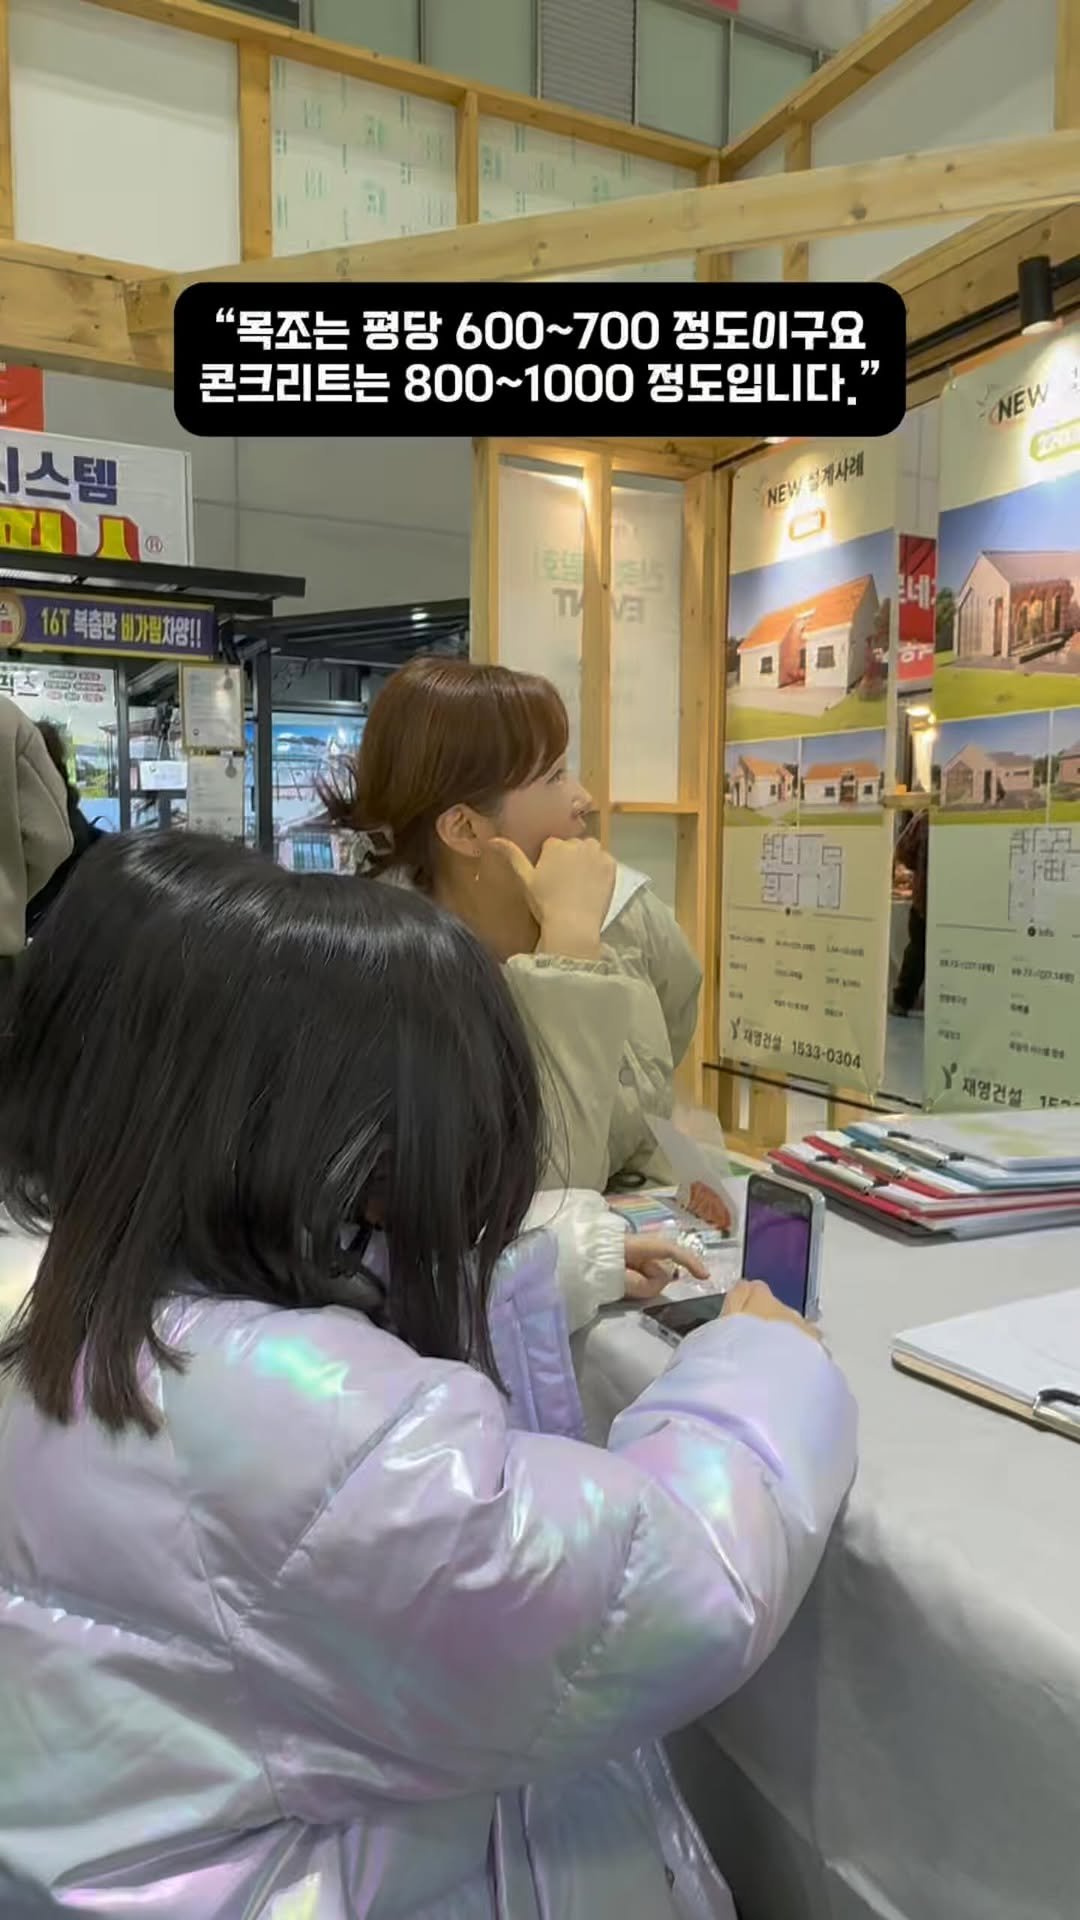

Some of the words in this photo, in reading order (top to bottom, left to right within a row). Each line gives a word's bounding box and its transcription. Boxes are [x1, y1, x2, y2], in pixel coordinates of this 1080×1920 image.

[998, 382, 1048, 425] NEW
[767, 478, 803, 508] NEW
[41, 607, 71, 638] 16T
[73, 608, 118, 642] 복층판
[120, 612, 202, 649] 비가림차양!!
[743, 1027, 783, 1052] 재영건설
[792, 1039, 862, 1070] 1533-0304
[962, 1075, 1024, 1109] 재영건설
